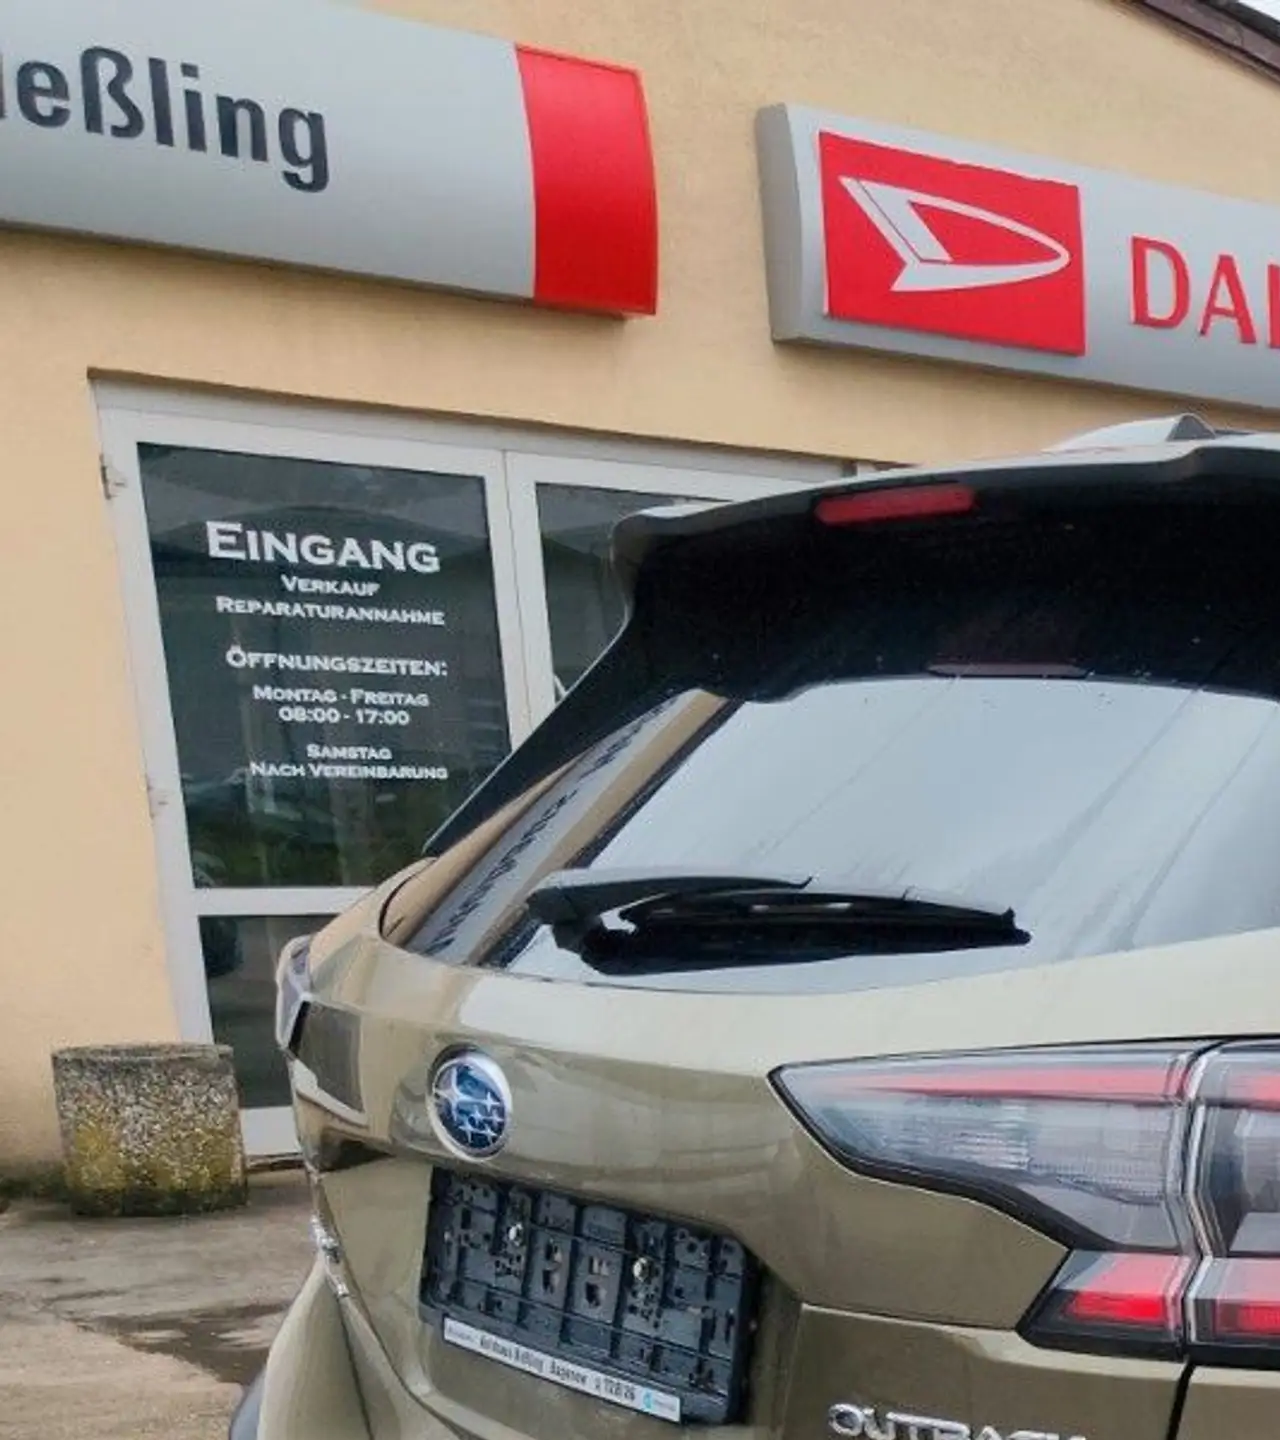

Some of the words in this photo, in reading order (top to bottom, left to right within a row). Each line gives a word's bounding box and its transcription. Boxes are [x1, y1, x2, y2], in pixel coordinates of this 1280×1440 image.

[0, 46, 329, 192] eßling
[206, 520, 440, 573] EINGANG
[281, 573, 381, 597] VERKAUF
[216, 595, 446, 626] REPARATURANNAHME
[225, 644, 448, 677] ÖFFNUNGSZEITEN:
[252, 684, 338, 703] MONTAG
[351, 688, 430, 707] FREITAG
[278, 705, 340, 724] 08:00
[356, 708, 410, 726] 17:00
[306, 743, 393, 761] SAMSTAG
[250, 760, 306, 778] NACH
[307, 762, 449, 780] VEREINBARUNG
